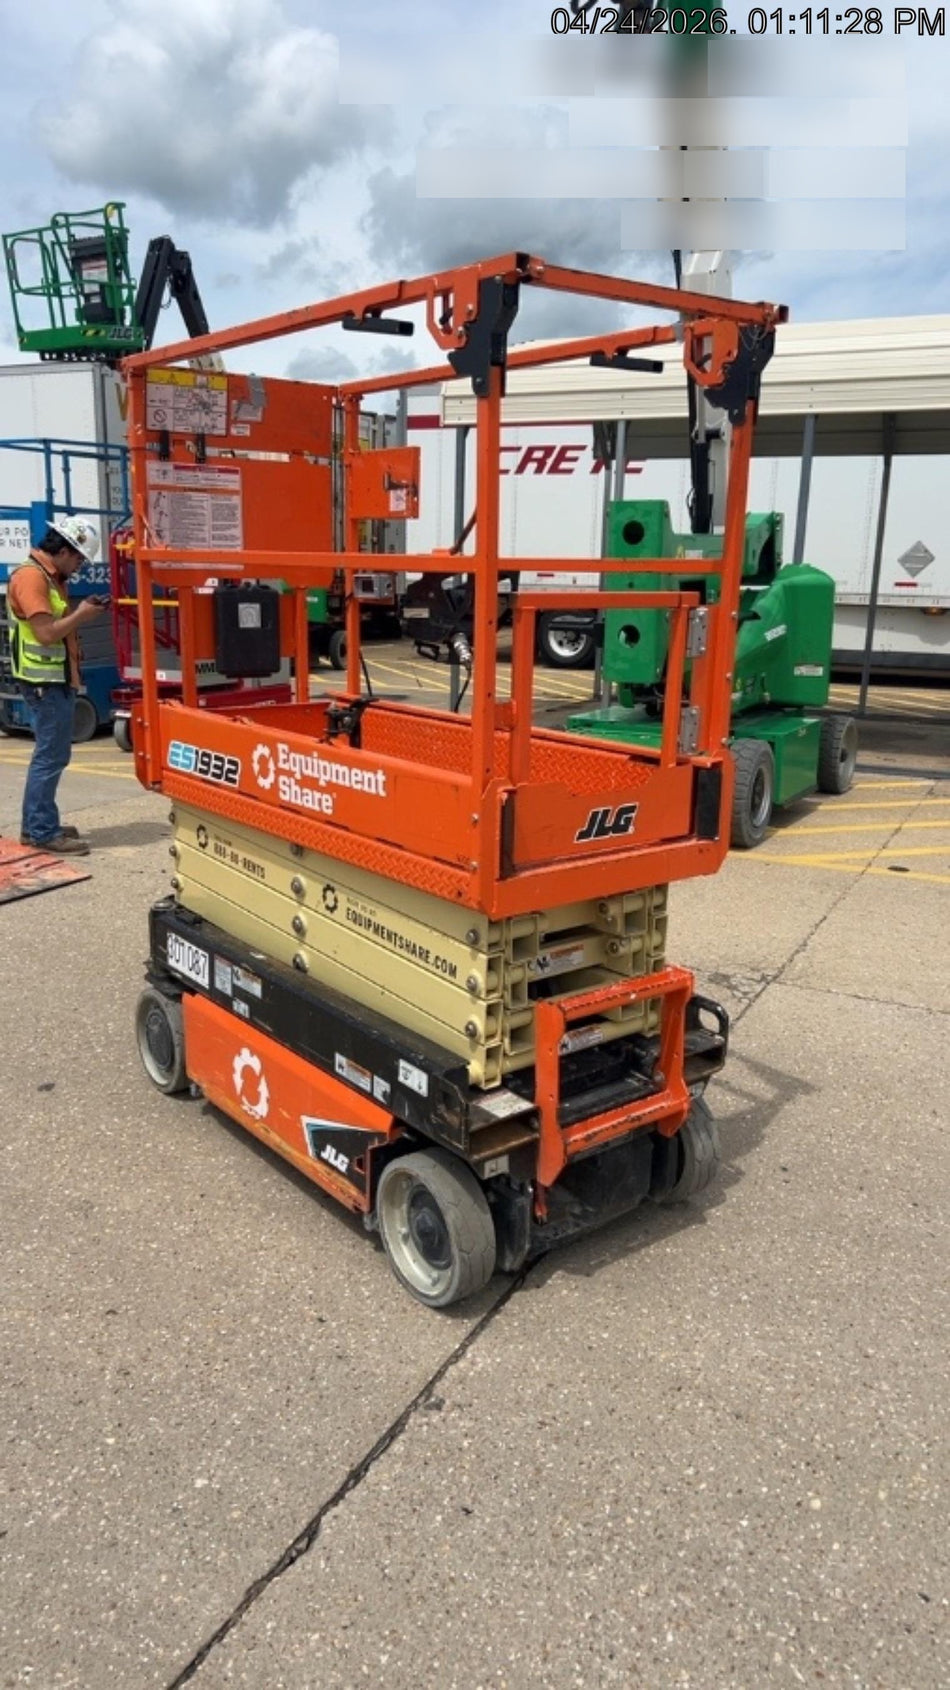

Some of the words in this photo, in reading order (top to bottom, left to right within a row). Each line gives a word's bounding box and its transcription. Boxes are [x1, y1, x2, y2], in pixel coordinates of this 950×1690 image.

[168, 741, 240, 786] ES1932
[276, 742, 387, 796] Equipment
[277, 775, 334, 815] Share
[575, 803, 638, 842] JLG
[345, 906, 457, 979] EQUIPMENTSHARE.COM
[320, 1144, 349, 1172] JLG
